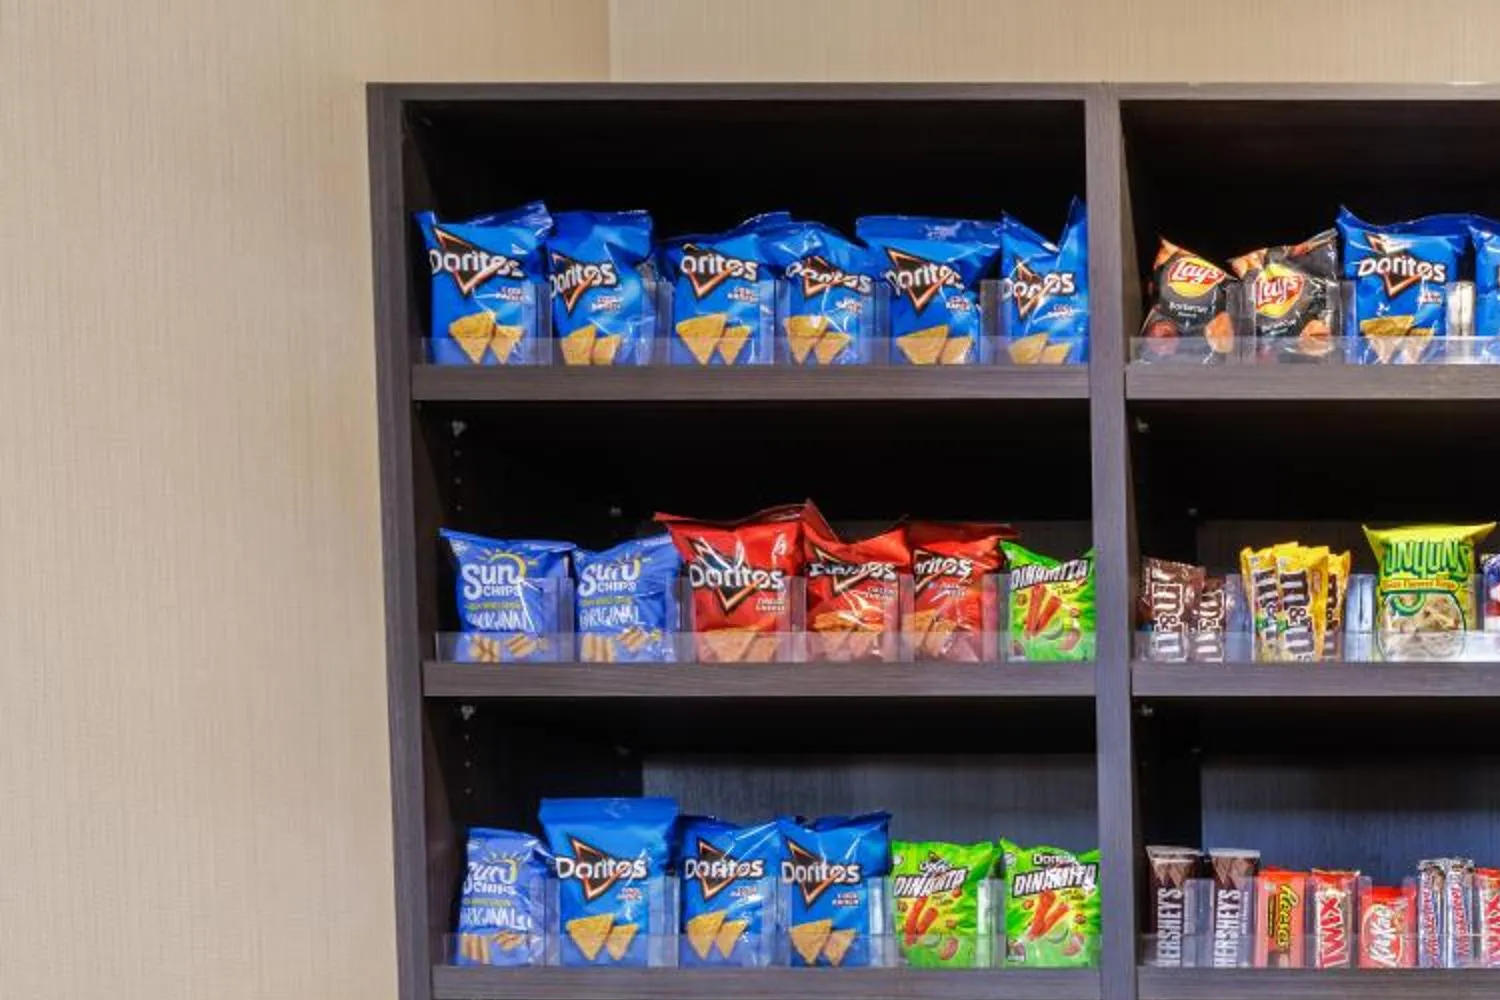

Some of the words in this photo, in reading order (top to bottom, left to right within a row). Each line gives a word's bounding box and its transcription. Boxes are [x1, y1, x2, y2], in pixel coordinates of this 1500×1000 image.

[429, 250, 525, 277] Doritos
[680, 253, 759, 281] oritos
[1358, 256, 1446, 283] Doritos
[461, 563, 519, 600] Sun
[689, 565, 785, 590] Doritos
[480, 585, 521, 598] CHIPS
[555, 856, 648, 879] Doritos
[684, 857, 763, 879] Doritos
[780, 860, 861, 884] Doritos
[1319, 898, 1348, 967] TWIX
